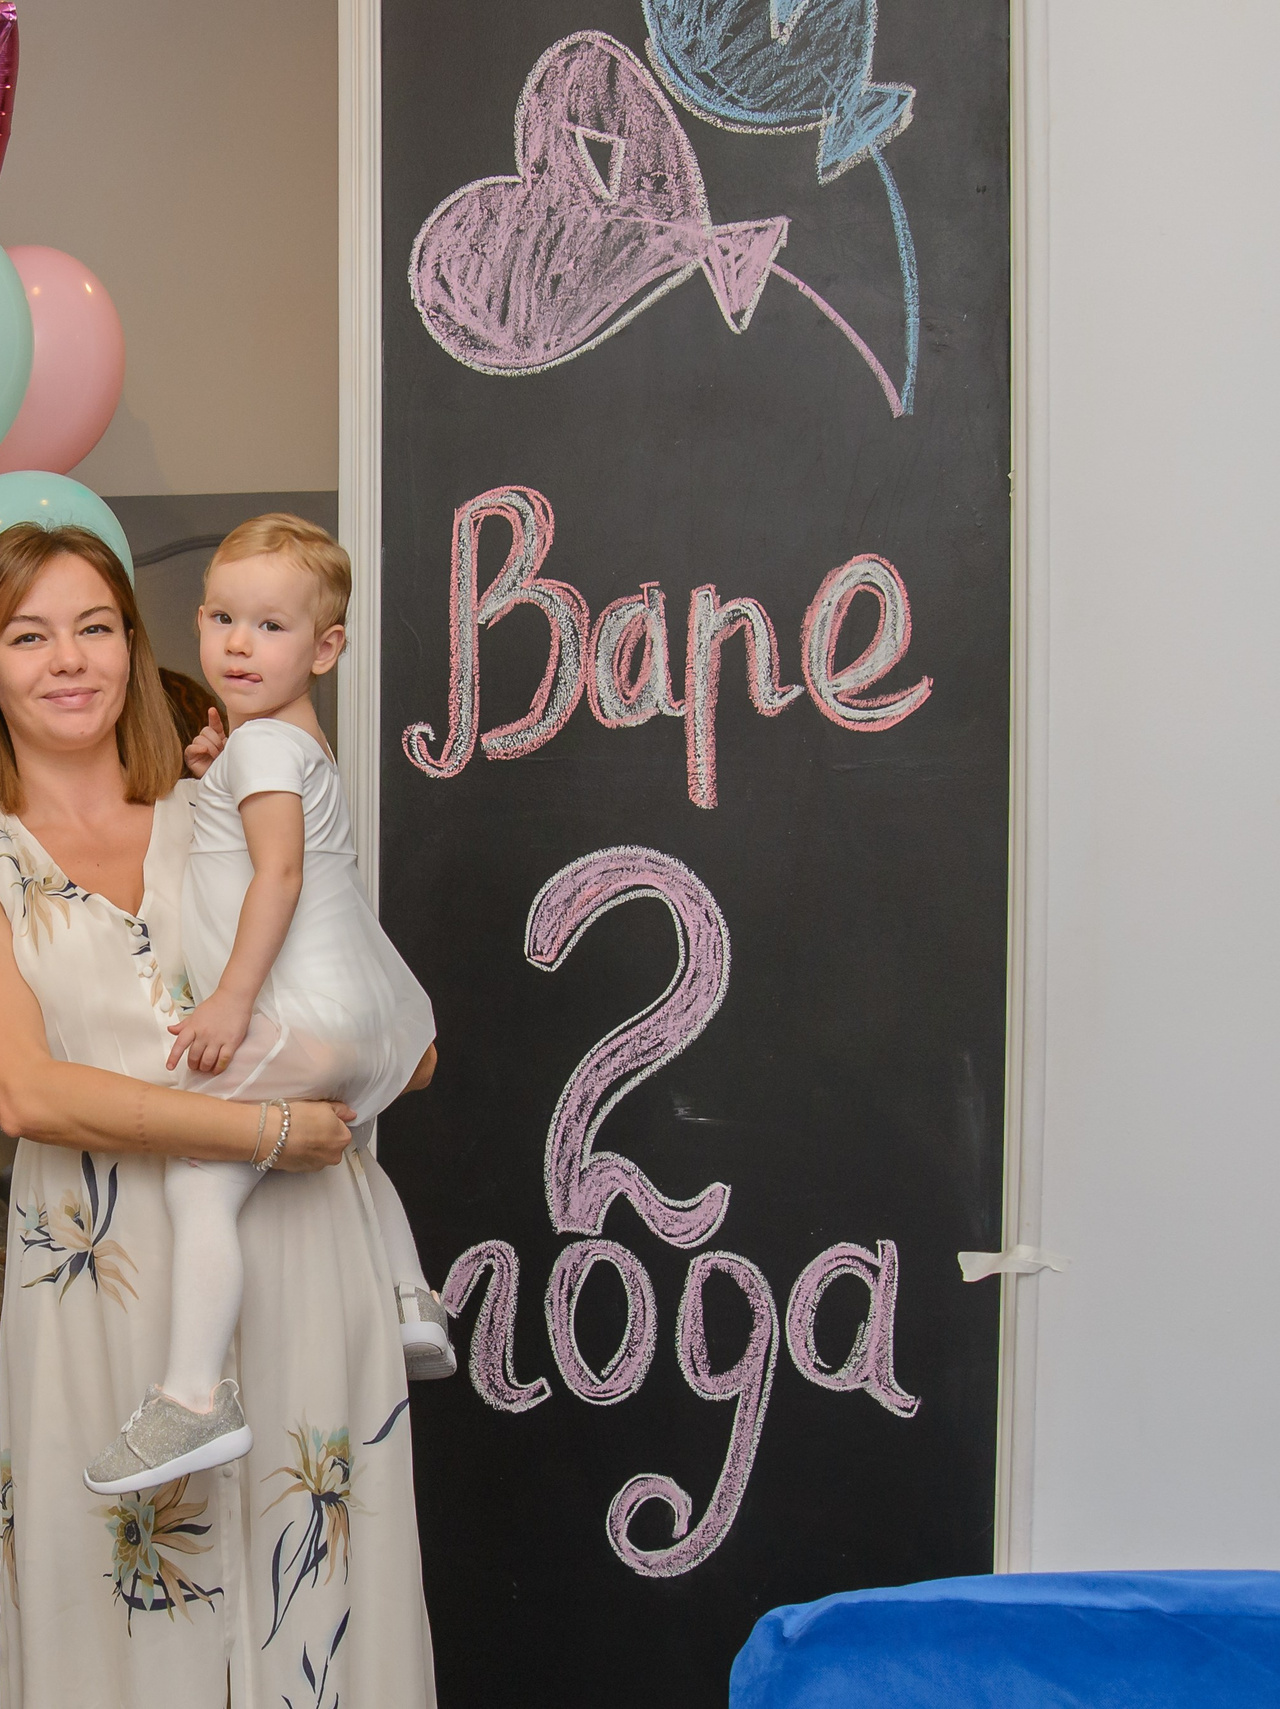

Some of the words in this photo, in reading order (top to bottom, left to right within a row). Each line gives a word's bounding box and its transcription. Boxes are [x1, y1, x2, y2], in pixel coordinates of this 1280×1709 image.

[401, 485, 934, 809] Варе
[524, 845, 732, 1249] 2
[440, 1239, 922, 1578] года
